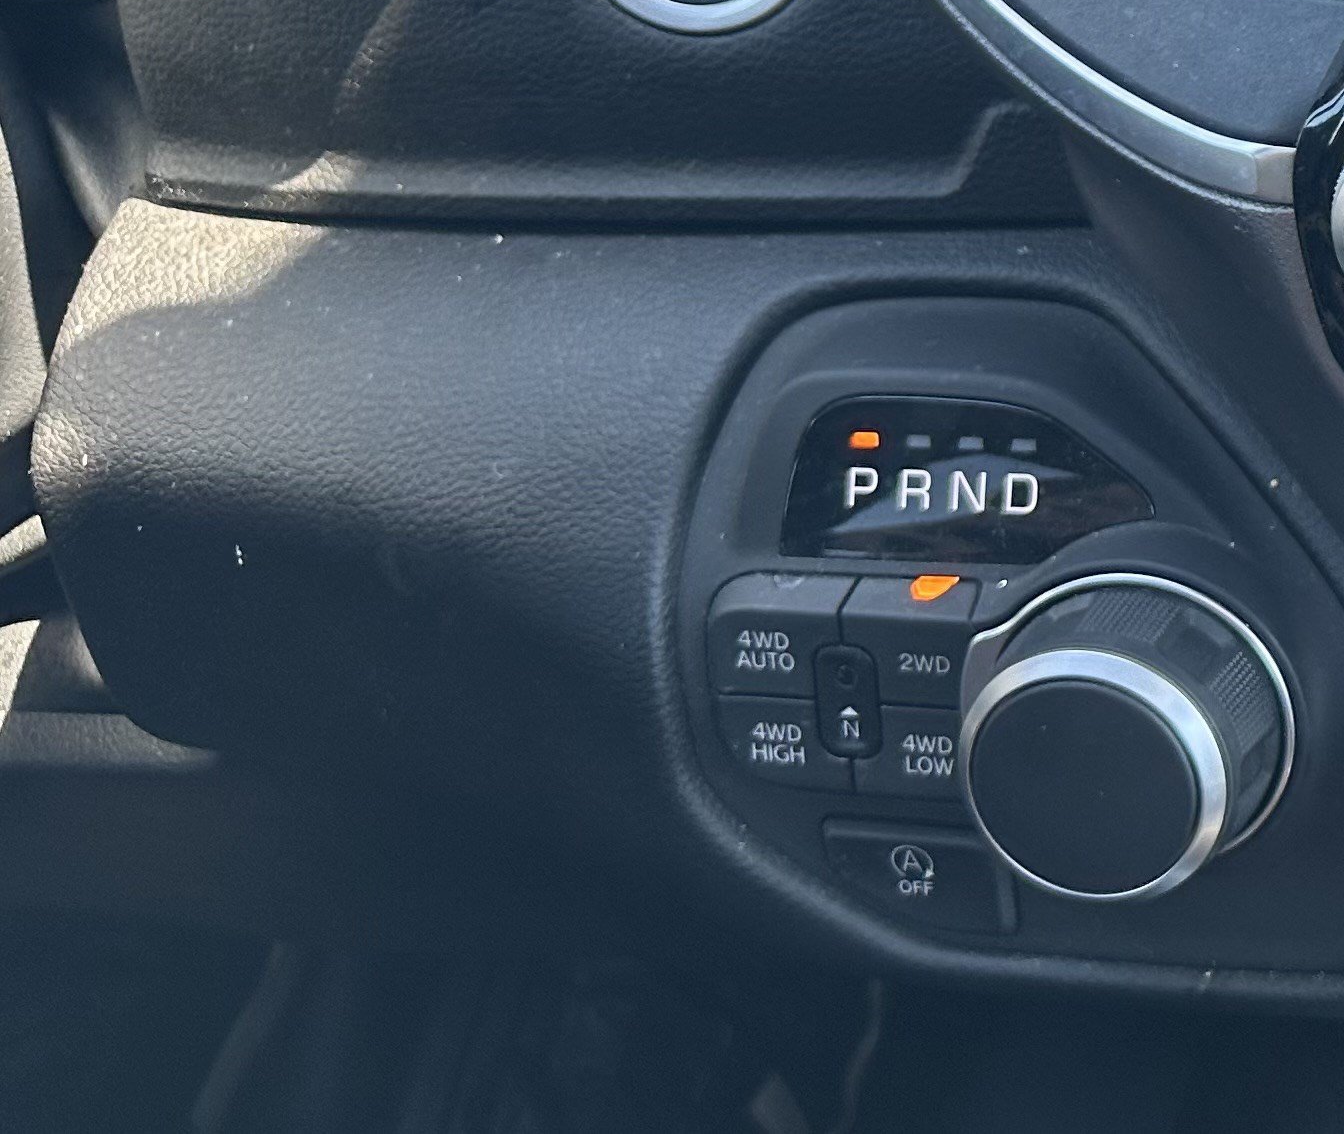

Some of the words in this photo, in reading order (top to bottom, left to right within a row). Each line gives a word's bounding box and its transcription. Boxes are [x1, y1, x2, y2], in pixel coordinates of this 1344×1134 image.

[844, 466, 879, 508] P
[900, 468, 931, 511] R
[948, 470, 986, 514] N
[1003, 471, 1039, 516] D
[737, 630, 789, 651] 4WD
[737, 651, 795, 671] AUTO
[900, 654, 951, 674] 2WD
[752, 722, 802, 743] 4WD
[842, 719, 860, 739] N
[751, 743, 806, 764] HIGH
[903, 734, 953, 755] 4WD
[905, 756, 954, 776] LOW
[899, 879, 934, 896] OFF
